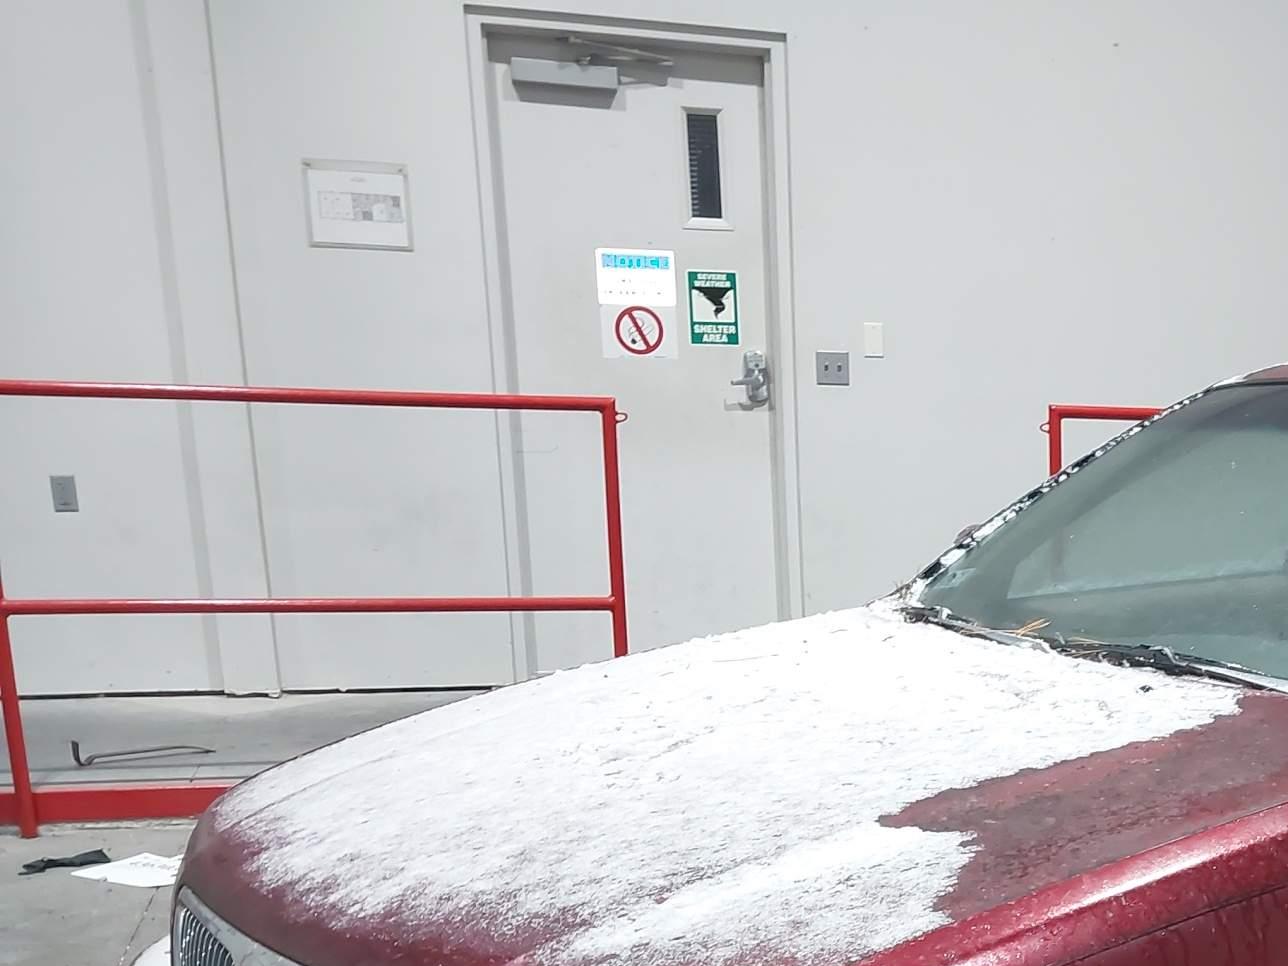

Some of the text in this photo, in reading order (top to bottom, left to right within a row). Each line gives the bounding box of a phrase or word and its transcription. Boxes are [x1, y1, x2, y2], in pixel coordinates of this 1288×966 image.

[602, 254, 670, 269] NOTICE
[697, 273, 727, 281] SEVERE
[694, 280, 731, 288] WEATHER
[693, 324, 736, 334] SHELTER
[702, 334, 728, 343] AREA
